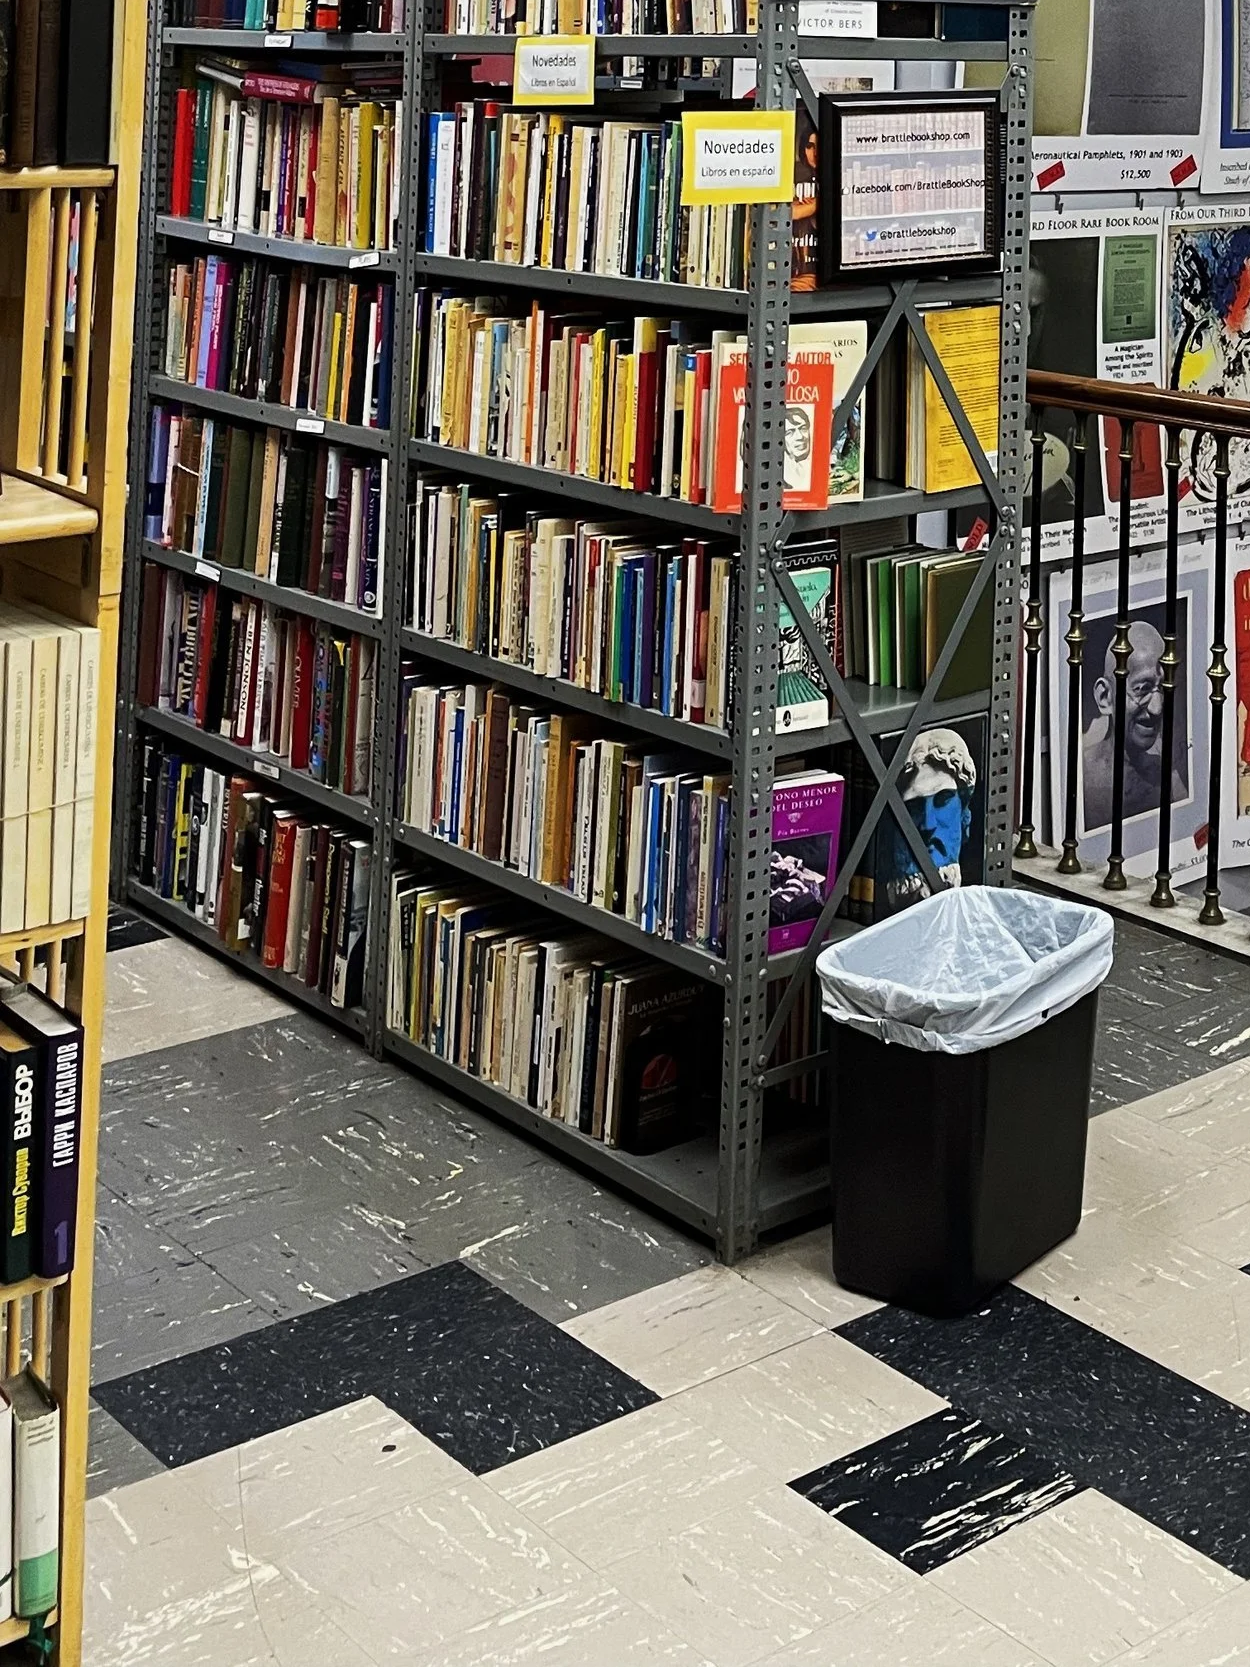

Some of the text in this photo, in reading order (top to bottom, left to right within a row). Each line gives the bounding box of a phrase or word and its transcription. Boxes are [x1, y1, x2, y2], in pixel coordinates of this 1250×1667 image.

[838, 18, 863, 29] BERS
[532, 53, 577, 68] Novedades
[703, 139, 775, 155] Novedades
[701, 165, 776, 180] Libros en español
[879, 225, 957, 241] @brattlebookshop
[795, 351, 832, 365] AUTOR
[246, 630, 255, 657] BEN
[800, 785, 838, 799] MENOR
[791, 797, 824, 811] DESEO
[13, 1063, 34, 1141] ВЫБОР
[53, 1041, 79, 1169] ГАРРИ КАСПАРОВ
